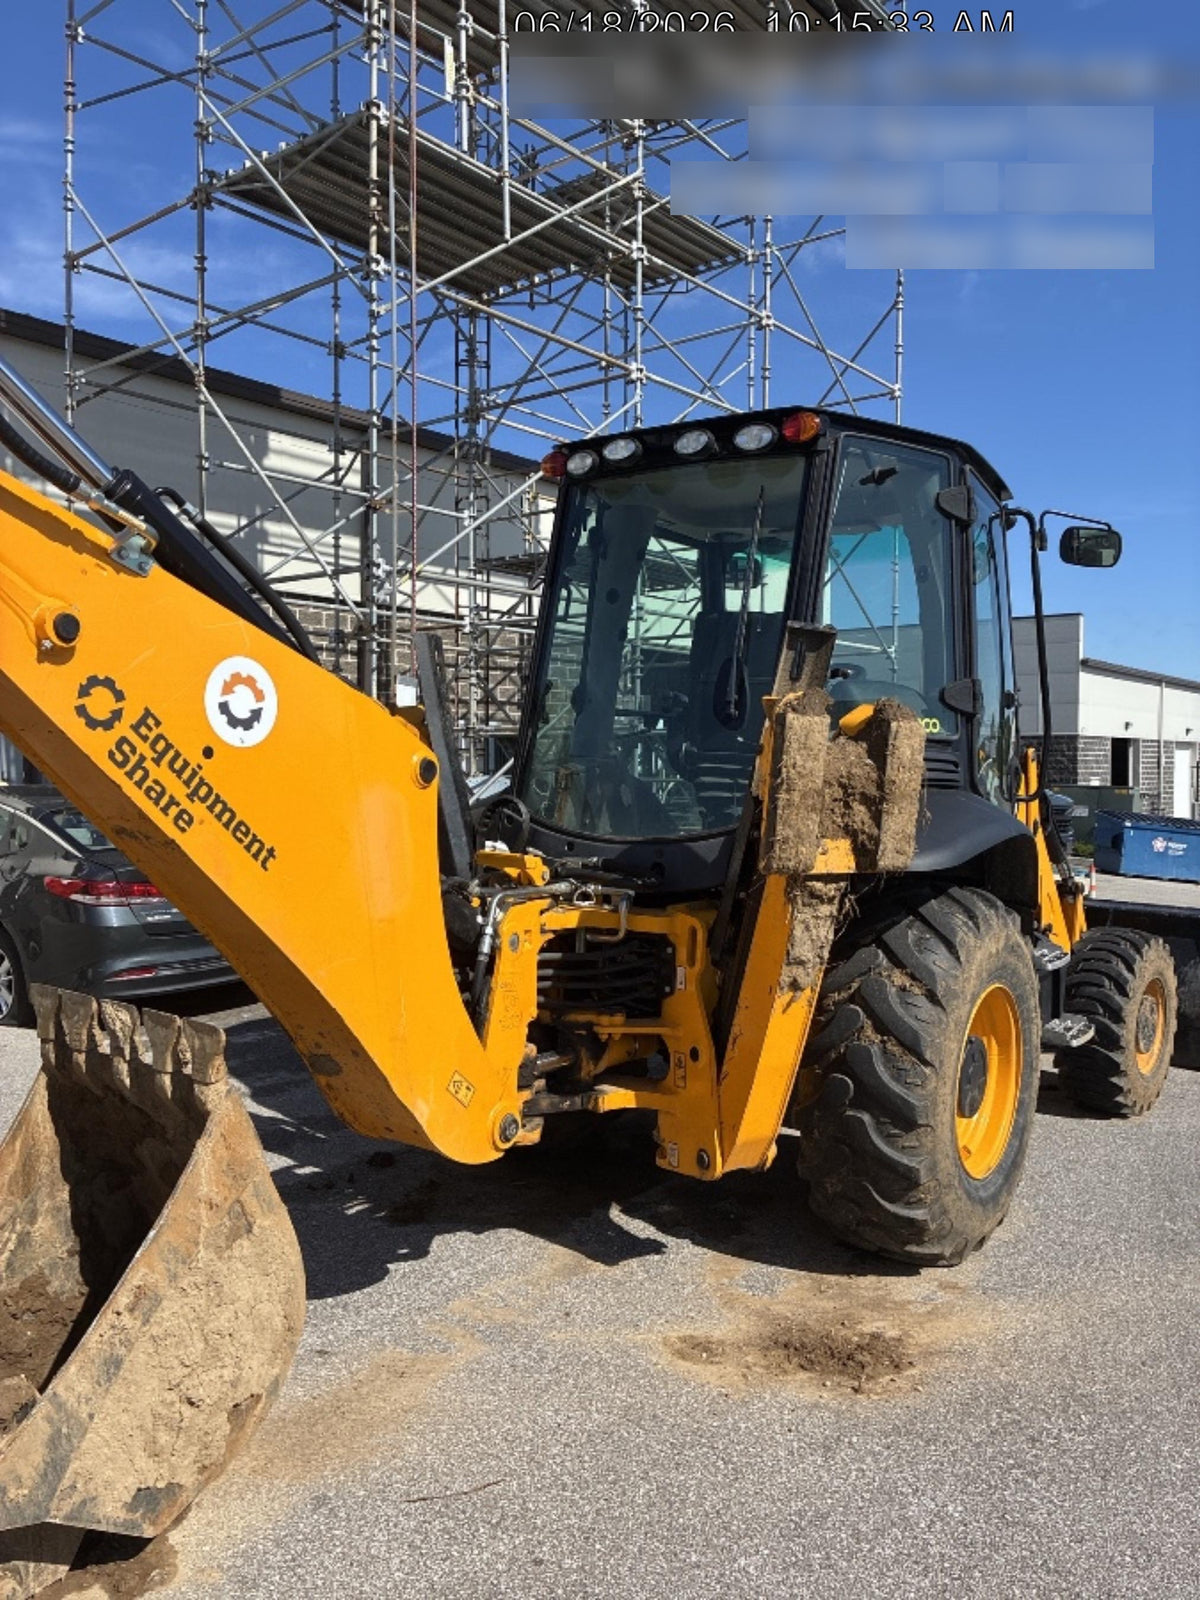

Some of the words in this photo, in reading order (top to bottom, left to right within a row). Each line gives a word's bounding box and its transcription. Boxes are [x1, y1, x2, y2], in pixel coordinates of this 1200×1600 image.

[917, 717, 940, 733] co
[107, 735, 194, 834] Share
[129, 705, 277, 871] Equipment
